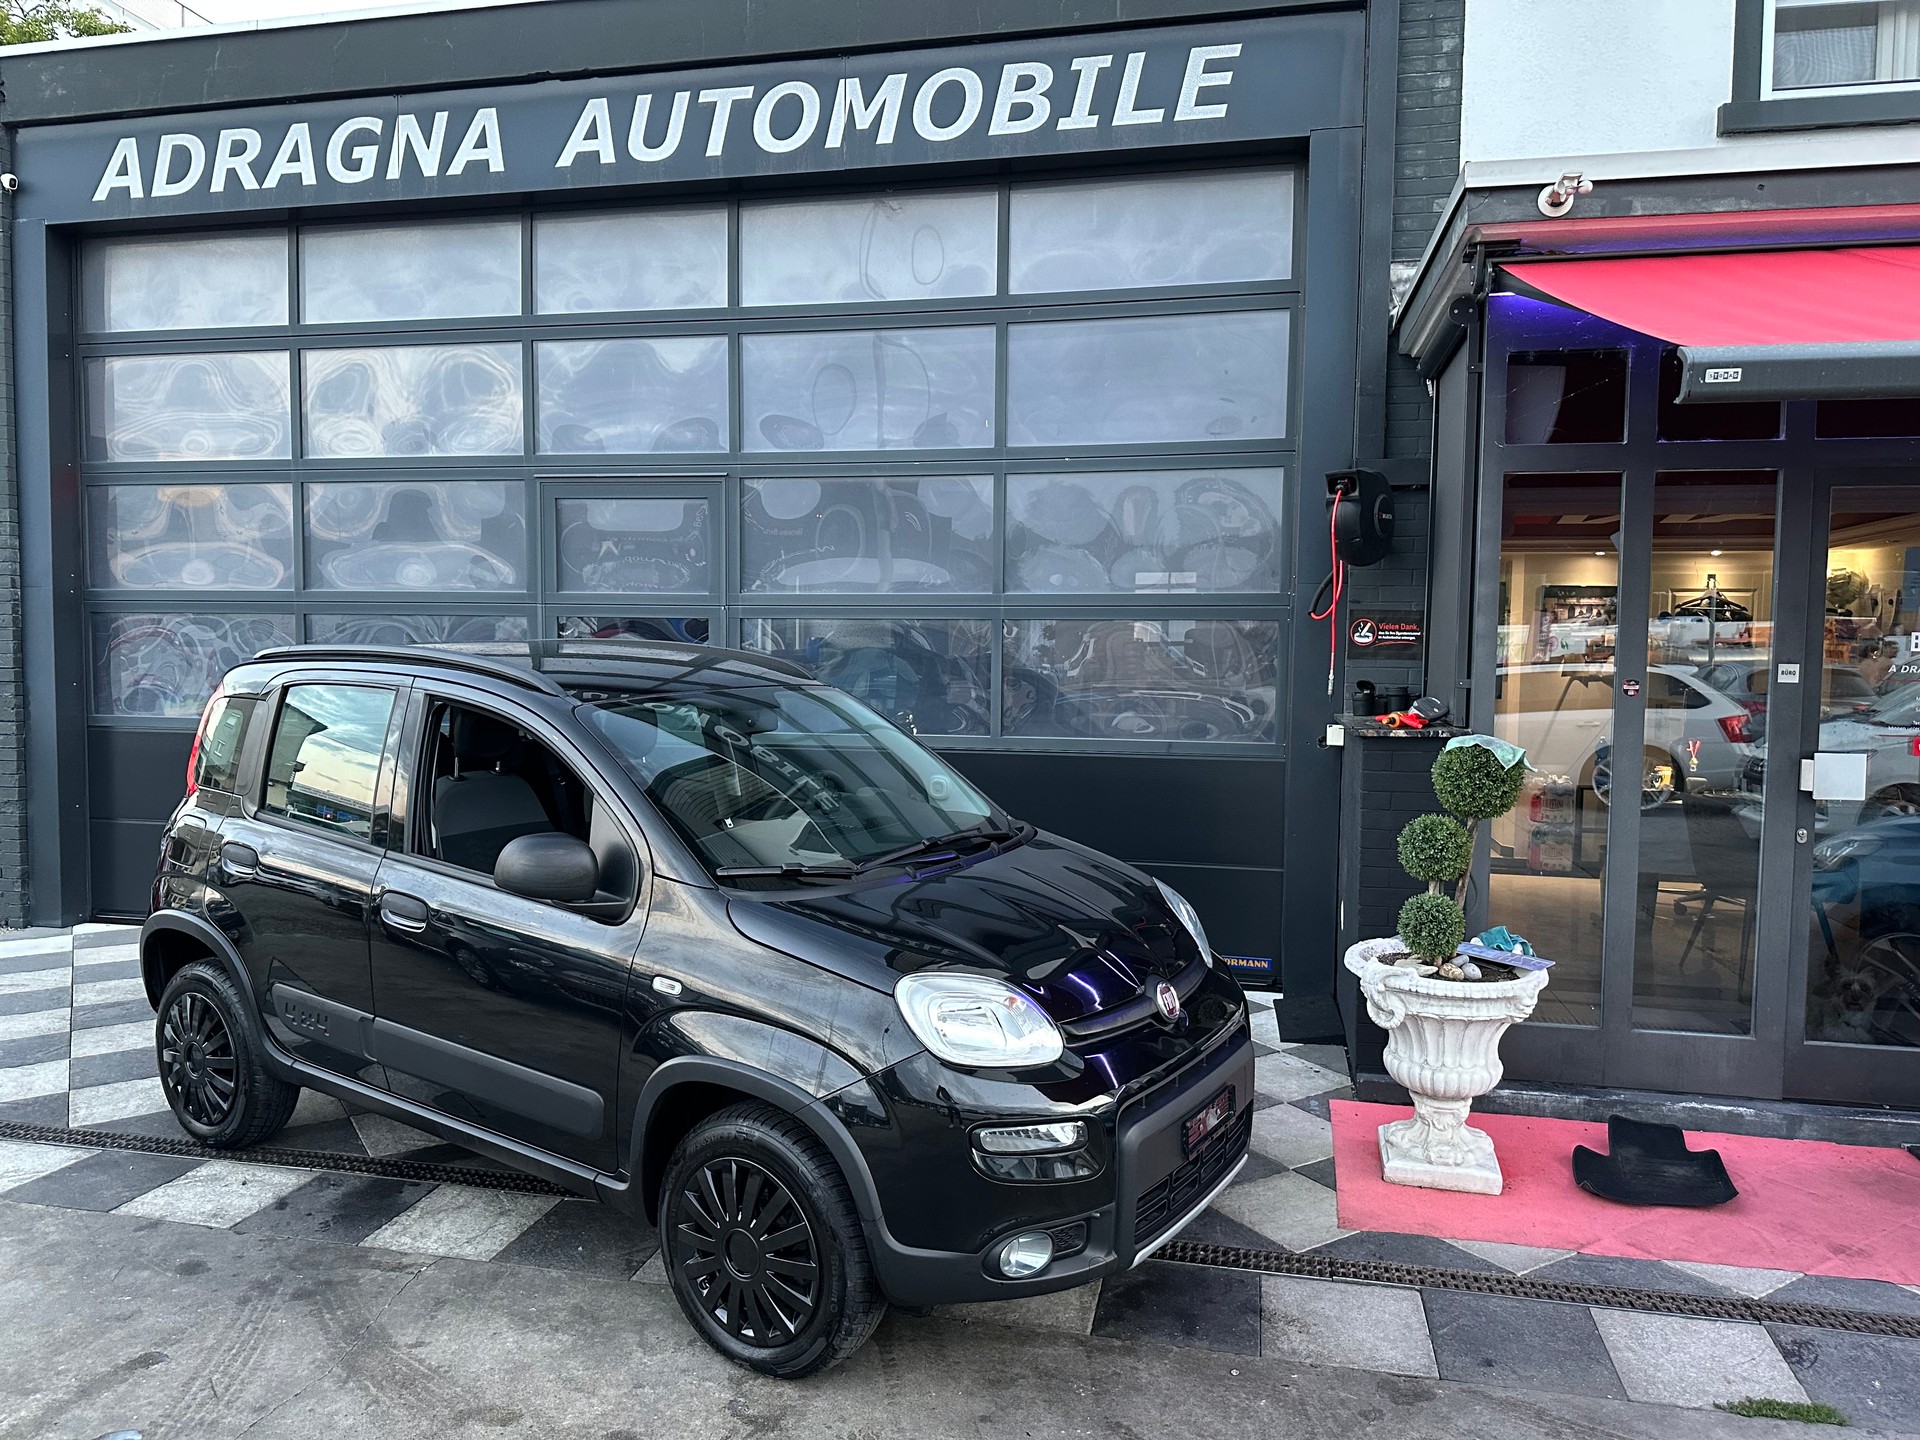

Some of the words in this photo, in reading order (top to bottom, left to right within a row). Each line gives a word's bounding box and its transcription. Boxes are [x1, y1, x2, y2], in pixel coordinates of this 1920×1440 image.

[92, 107, 505, 202] ADRAGNA
[554, 43, 1243, 168] AUTOMOBILE
[1223, 957, 1269, 968] ÖRMANN
[285, 1002, 330, 1036] 4x4
